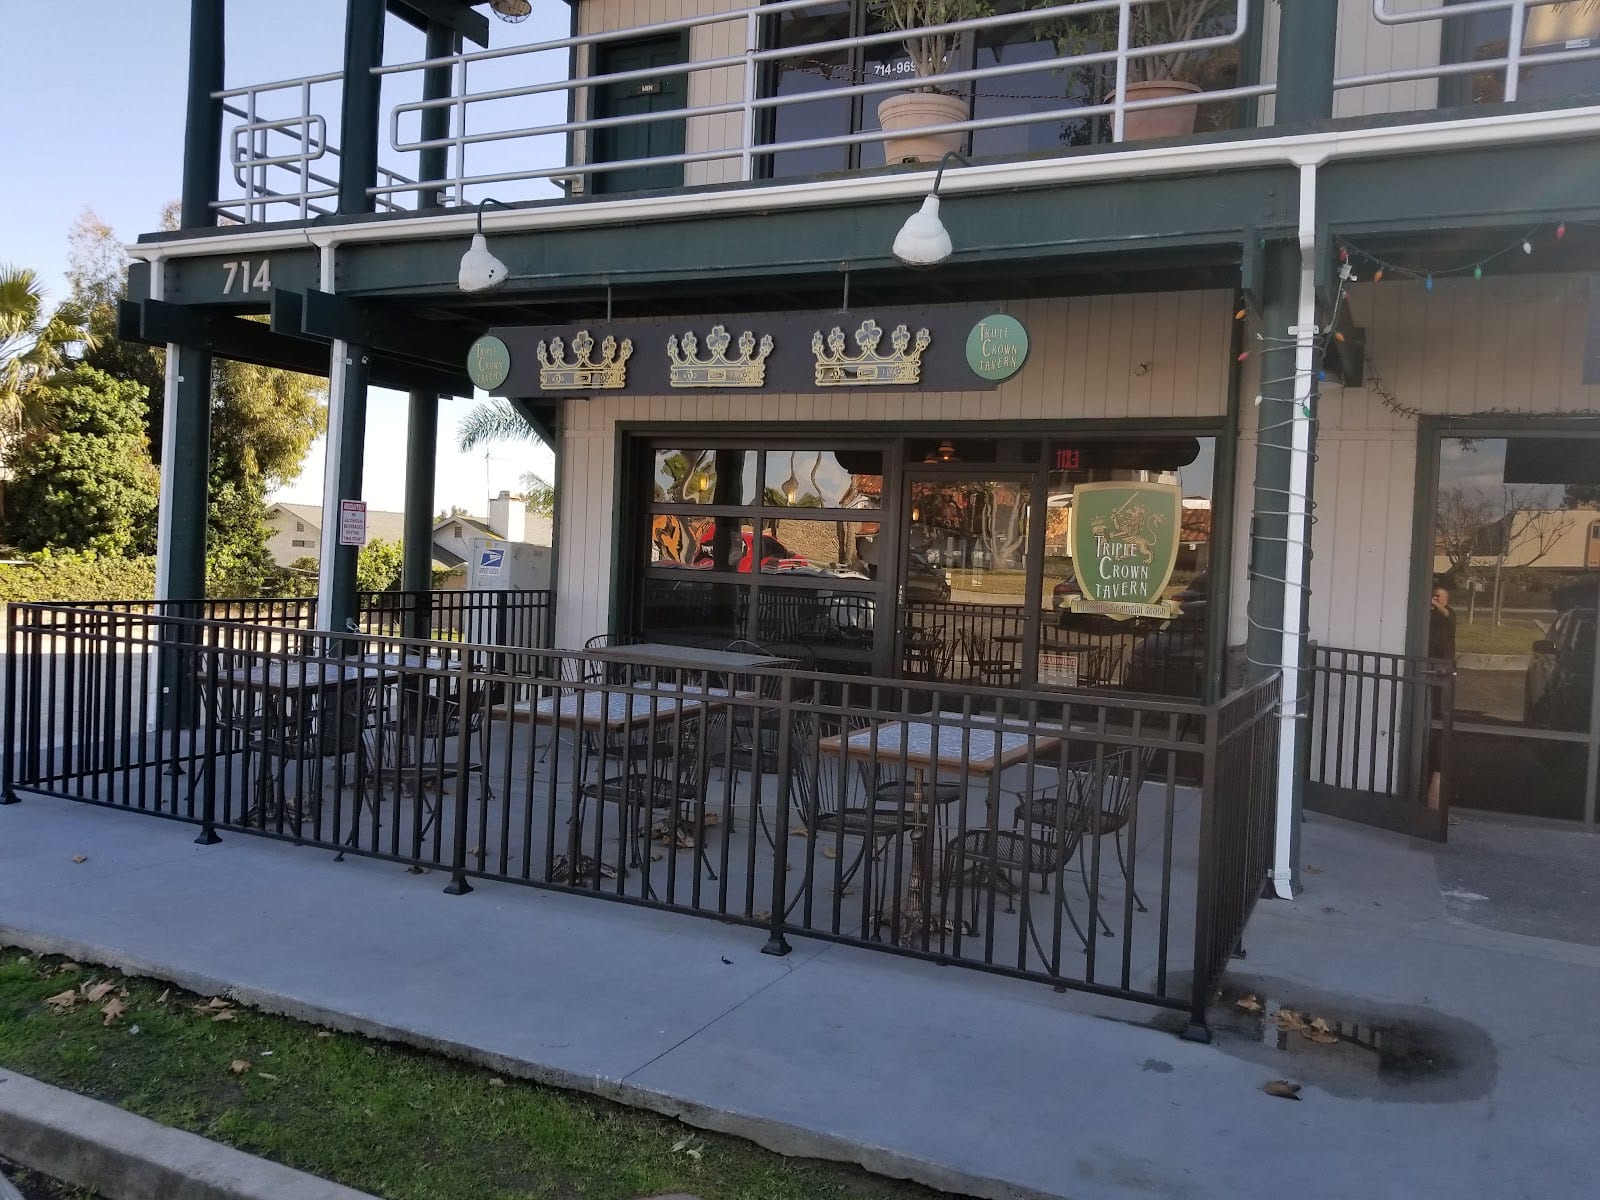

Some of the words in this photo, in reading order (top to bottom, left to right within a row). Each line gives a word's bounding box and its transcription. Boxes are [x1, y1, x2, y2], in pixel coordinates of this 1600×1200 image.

[222, 259, 272, 295] 714
[978, 322, 1009, 341] TRIPLE
[982, 338, 1017, 358] CROWN
[979, 355, 1017, 372] TAVERN
[1094, 535, 1137, 558] TRIPLE
[1099, 556, 1148, 580] CROWN
[1096, 580, 1148, 599] TAVERN
[1040, 656, 1077, 667] WARNING
